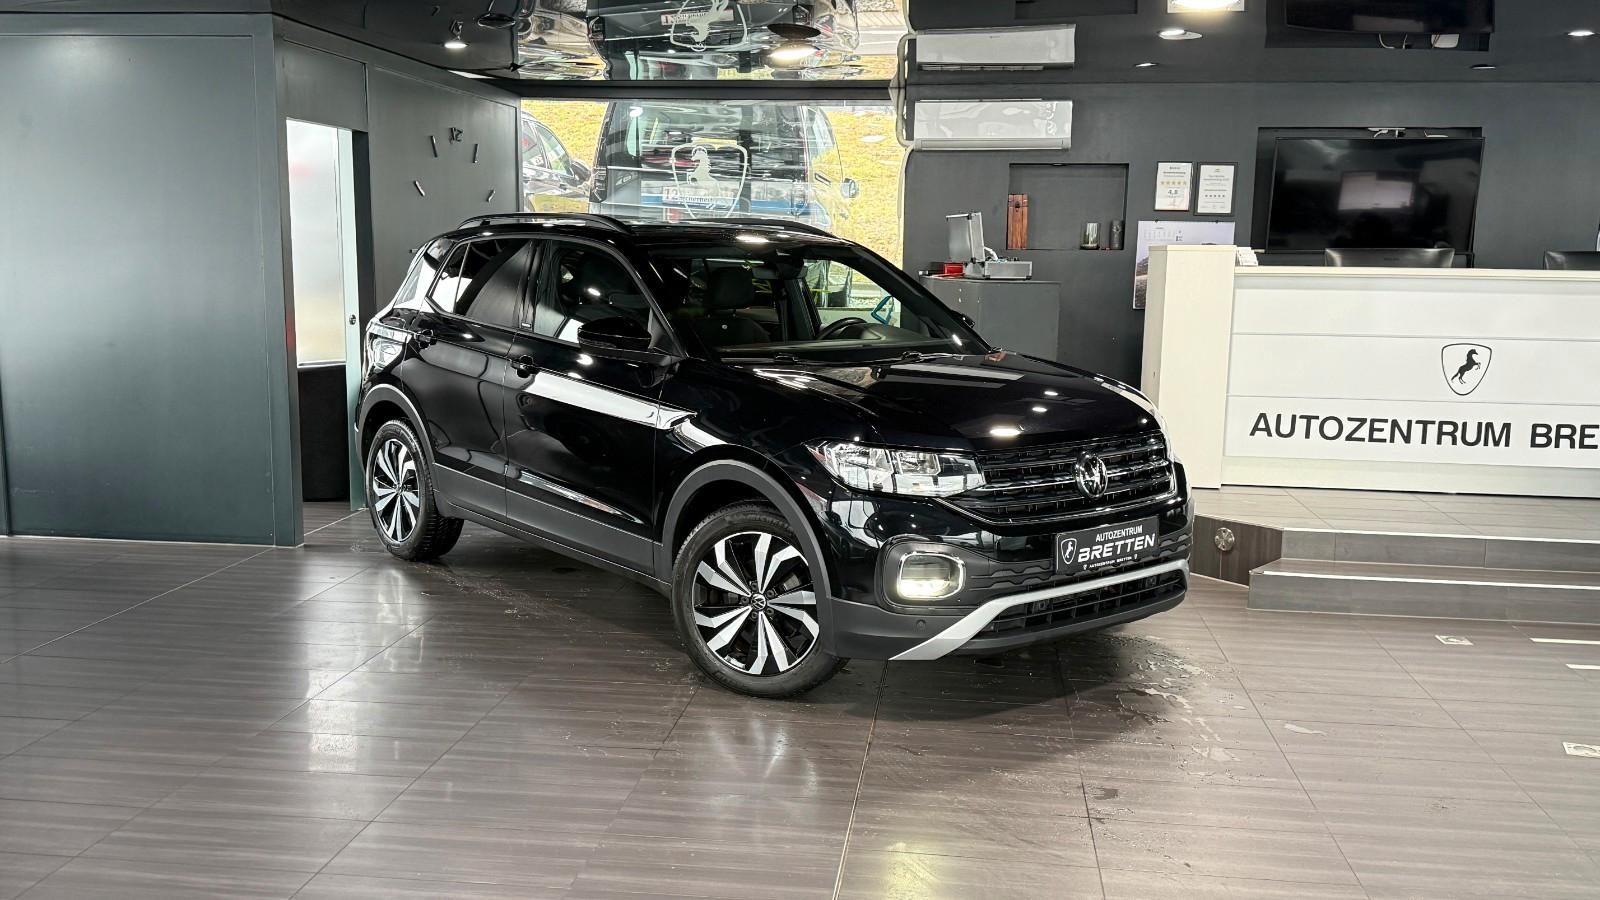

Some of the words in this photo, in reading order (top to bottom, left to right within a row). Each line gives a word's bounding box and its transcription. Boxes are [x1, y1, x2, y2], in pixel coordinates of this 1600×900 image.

[1249, 412, 1512, 448] AUTOZENTRUM
[1529, 423, 1600, 450] BRE
[1078, 533, 1155, 562] BRETTEN
[1096, 524, 1143, 542] AUTOZENTRUM
